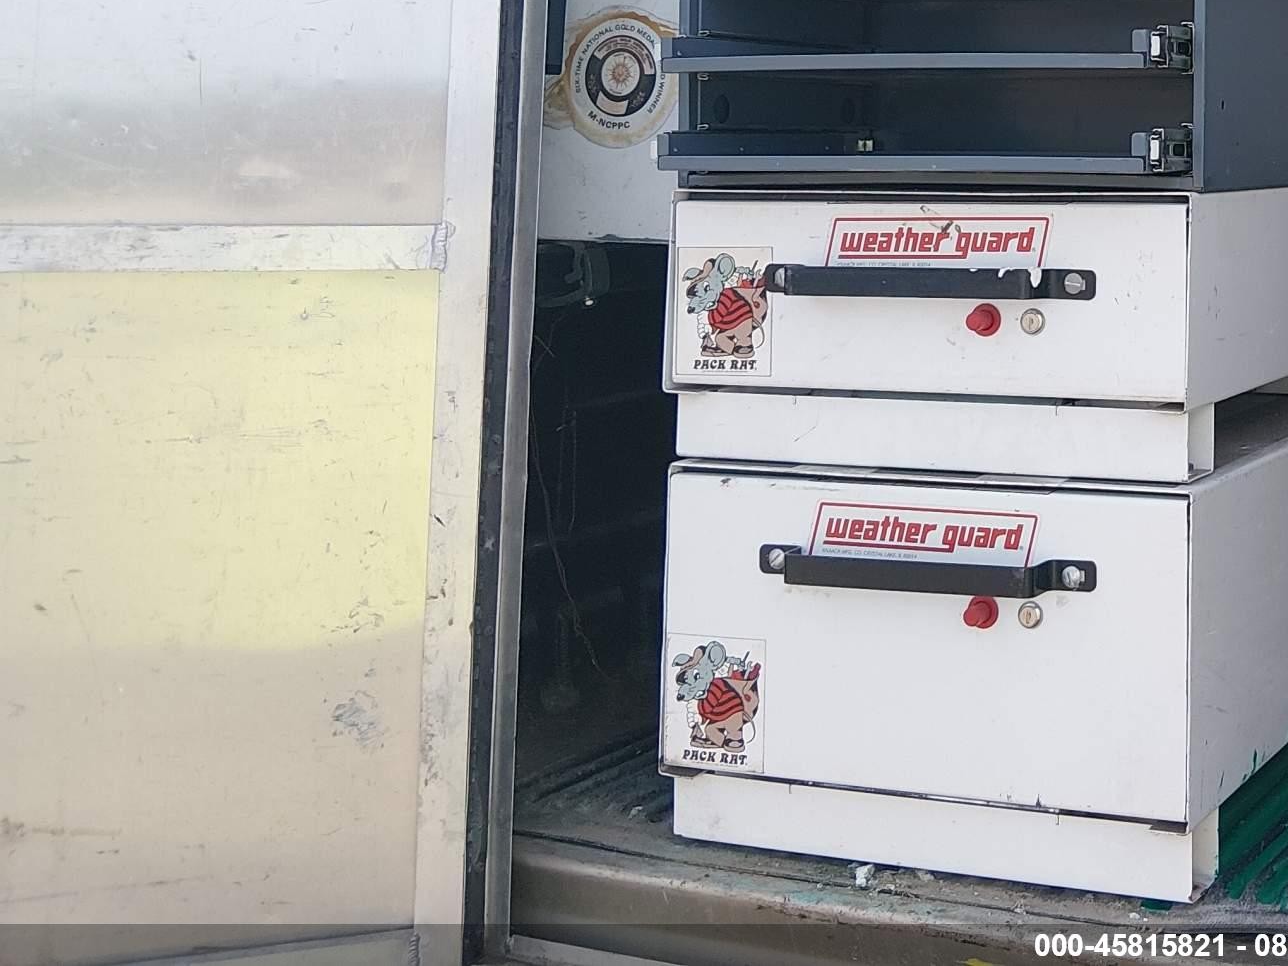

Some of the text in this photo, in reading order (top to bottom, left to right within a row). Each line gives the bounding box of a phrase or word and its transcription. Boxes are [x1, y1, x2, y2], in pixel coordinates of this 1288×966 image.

[582, 27, 614, 55] NATIONAL
[614, 24, 636, 32] GOLD
[646, 81, 665, 114] WINNER
[587, 110, 631, 130] M-NCPPC
[839, 227, 1036, 259] weather guard
[693, 359, 727, 370] PACK
[825, 515, 1024, 553] weather guard
[682, 749, 716, 763] PACK
